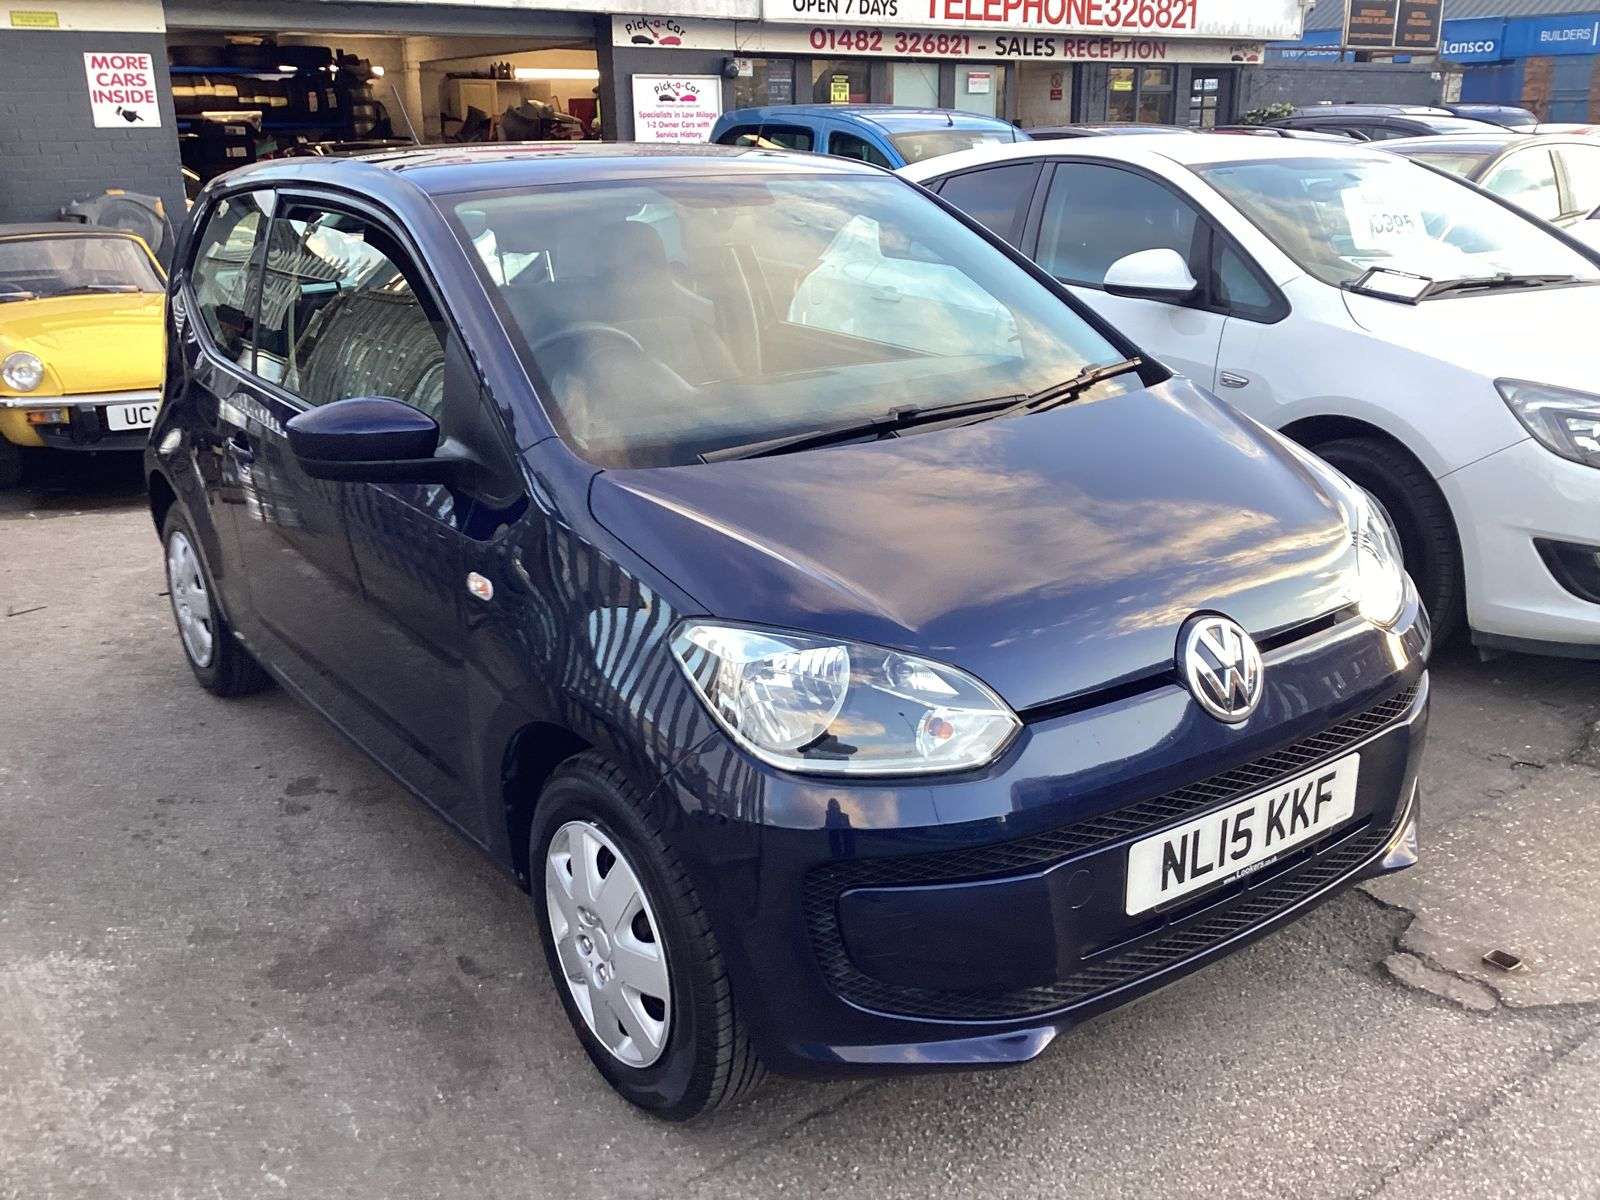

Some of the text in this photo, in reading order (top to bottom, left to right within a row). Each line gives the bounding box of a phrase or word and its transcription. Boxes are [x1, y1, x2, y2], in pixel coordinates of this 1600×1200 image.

[793, 0, 839, 13] OPEN
[859, 0, 898, 17] DAYS
[1540, 28, 1592, 43] BUILDERS
[809, 27, 883, 51] 01482
[894, 31, 970, 55] 326821
[995, 36, 1056, 57] SALES
[1063, 38, 1167, 60] RECEPTION
[1443, 40, 1495, 55] Lansco
[90, 56, 149, 70] MORE
[96, 73, 148, 87] CARS
[92, 90, 156, 104] INSIDE
[639, 111, 672, 119] Specialists
[1161, 770, 1337, 892] NL15 KKF
